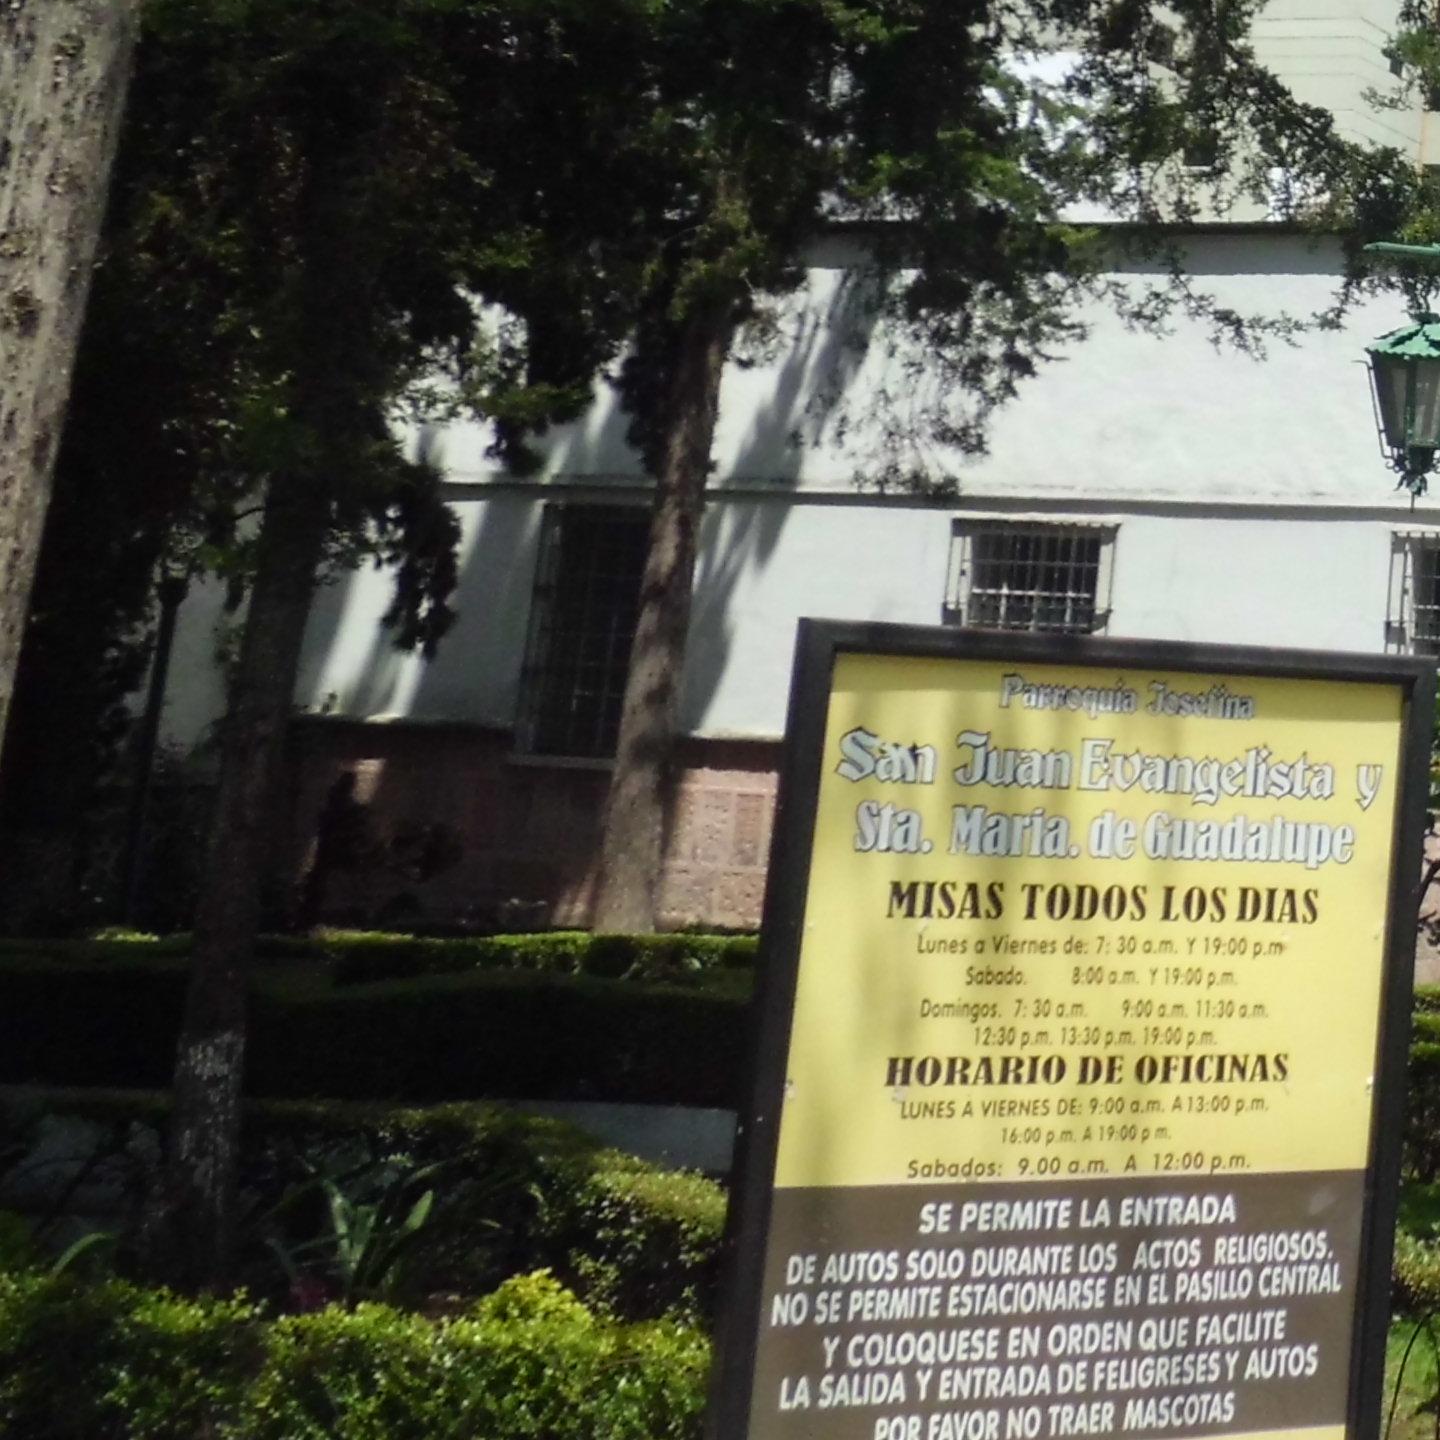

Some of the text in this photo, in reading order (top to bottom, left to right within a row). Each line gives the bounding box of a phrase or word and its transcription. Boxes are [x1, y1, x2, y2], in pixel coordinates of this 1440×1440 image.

[997, 672, 1256, 721] Parroquia Josefina
[834, 725, 1384, 812] San Juan Evangelista y
[854, 799, 933, 853] Sta.
[1088, 809, 1138, 860] de
[1142, 810, 1355, 870] Guadalupe
[885, 879, 1320, 925] MISAS TODOS LOS DIAS
[916, 934, 968, 955] Lunes
[973, 938, 986, 954] a
[992, 934, 1057, 956] Viernes
[1063, 934, 1089, 955] de:
[1186, 936, 1197, 956] Y
[1203, 936, 1248, 957] 19:00
[1072, 965, 1104, 985] 8:00
[1108, 970, 1140, 986] a.m.
[1149, 966, 1159, 986] Y
[1164, 966, 1203, 986] 19:00
[1206, 970, 1238, 990] p.m.
[1055, 1002, 1088, 1018] a.m.
[1121, 999, 1153, 1019] 9:00
[1157, 1003, 1189, 1019] a.m.
[1196, 999, 1234, 1019] 11:30
[1238, 1003, 1269, 1019] a.m.
[973, 1026, 1218, 1050] 12:30 p.m. 13:30 p.m. 19:00 p.m.
[883, 1052, 1290, 1088] HORARIO DE OFICINAS
[900, 1100, 957, 1120] LUNES
[961, 1100, 974, 1118] A
[981, 1098, 1050, 1118] VIERNES
[1056, 1098, 1083, 1116] DE:
[1089, 1096, 1125, 1116] 9:00
[1130, 1099, 1165, 1115] a.m.
[1234, 1097, 1270, 1117] p.m.
[1082, 1125, 1093, 1142] A
[1098, 1124, 1138, 1142] 19:00
[907, 1157, 1003, 1179] Sabados:
[1067, 1160, 1110, 1176] a.m.
[1123, 1153, 1138, 1172] A
[1153, 1151, 1205, 1172] 12:00
[1209, 1154, 1251, 1176] p.m.
[918, 1193, 1237, 1235] SE PERMITE LA ENTRADA
[786, 1230, 1334, 1287] DE AUTOS SOLO DURANTE LOS ACTOS RELIGIOSOS.
[770, 1262, 1344, 1328] NO SE PERMITE ESTACIONARSE EN EL PASILLO CENTRAL
[822, 1308, 1288, 1369] Y COLOQUESE EN ORDEN QUE FACILITE
[778, 1343, 1319, 1411] LA SALIDA Y ENTRADA DE FELIGRESES Y AUTOS
[873, 1391, 1236, 1440] POR FAVOR NO TRAER MASCOTAS
